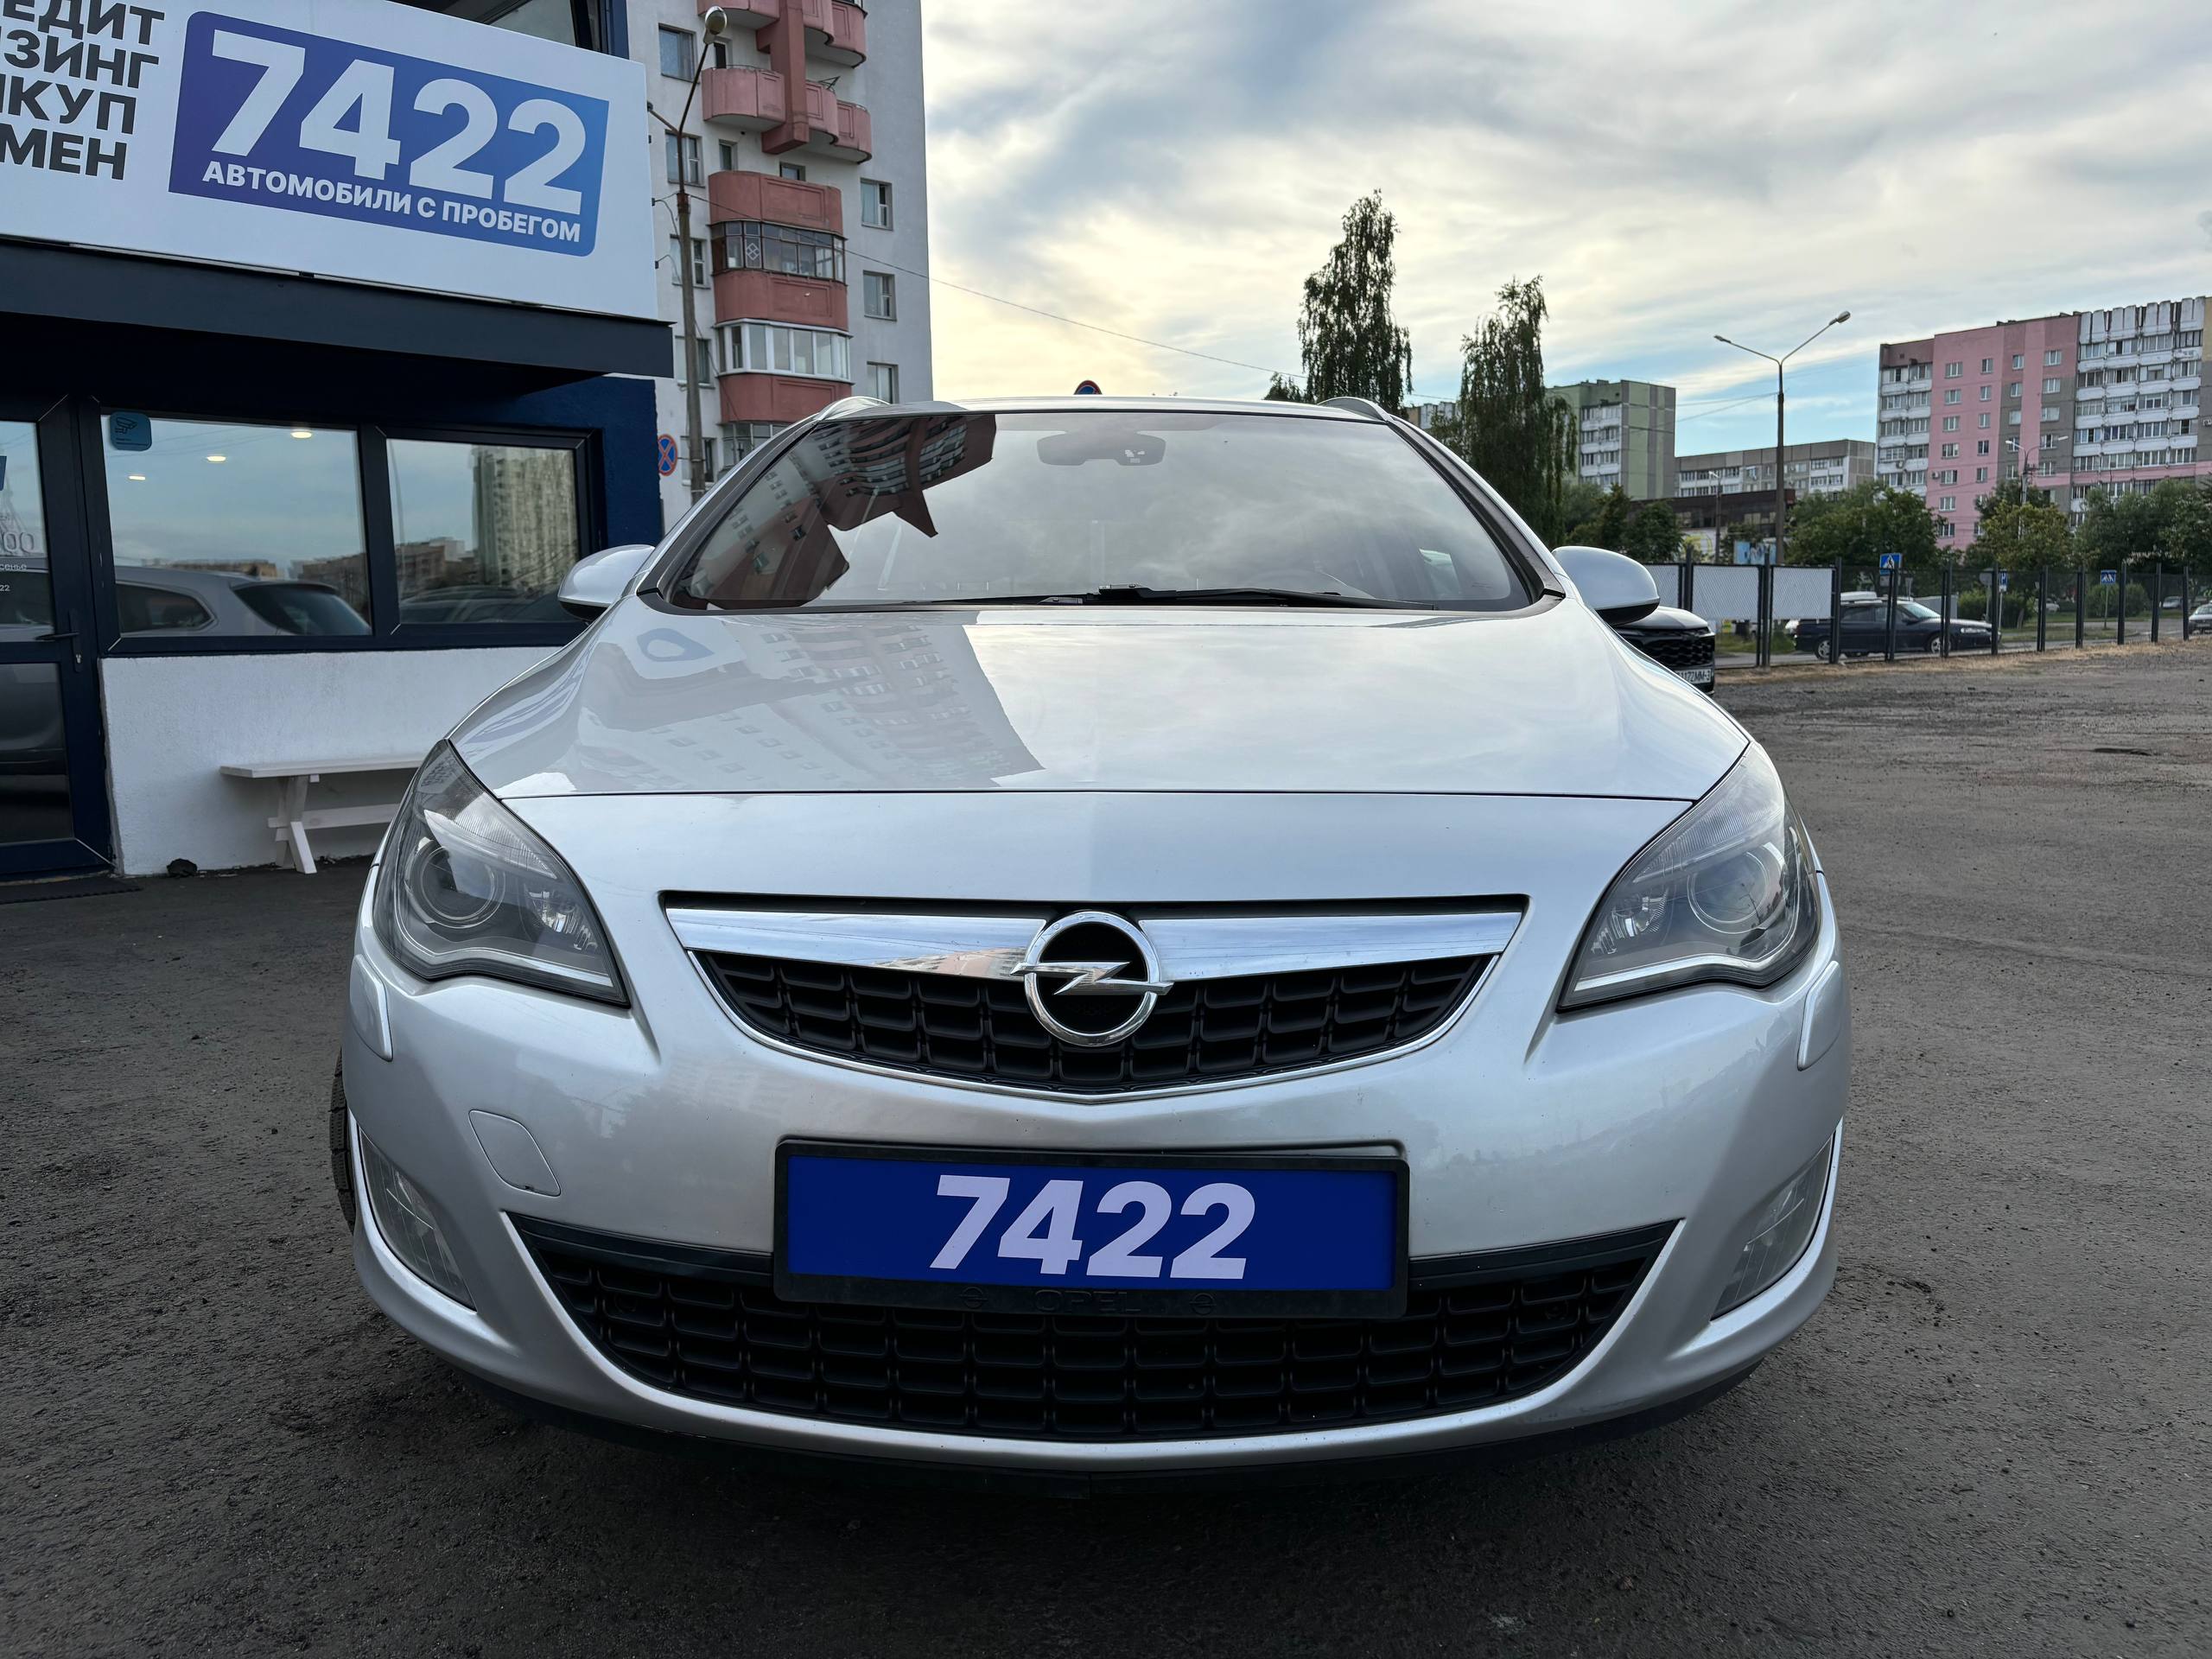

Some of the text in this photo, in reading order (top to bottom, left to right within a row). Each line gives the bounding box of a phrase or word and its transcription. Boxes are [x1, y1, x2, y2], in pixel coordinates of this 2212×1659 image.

[0, 27, 159, 89] ЗИНГ
[0, 73, 137, 135] КУП
[211, 29, 587, 215] 7422
[202, 161, 581, 243] АВТОМОБИЛИ С ПРОБЕГОМ
[929, 1173, 1256, 1281] 7422
